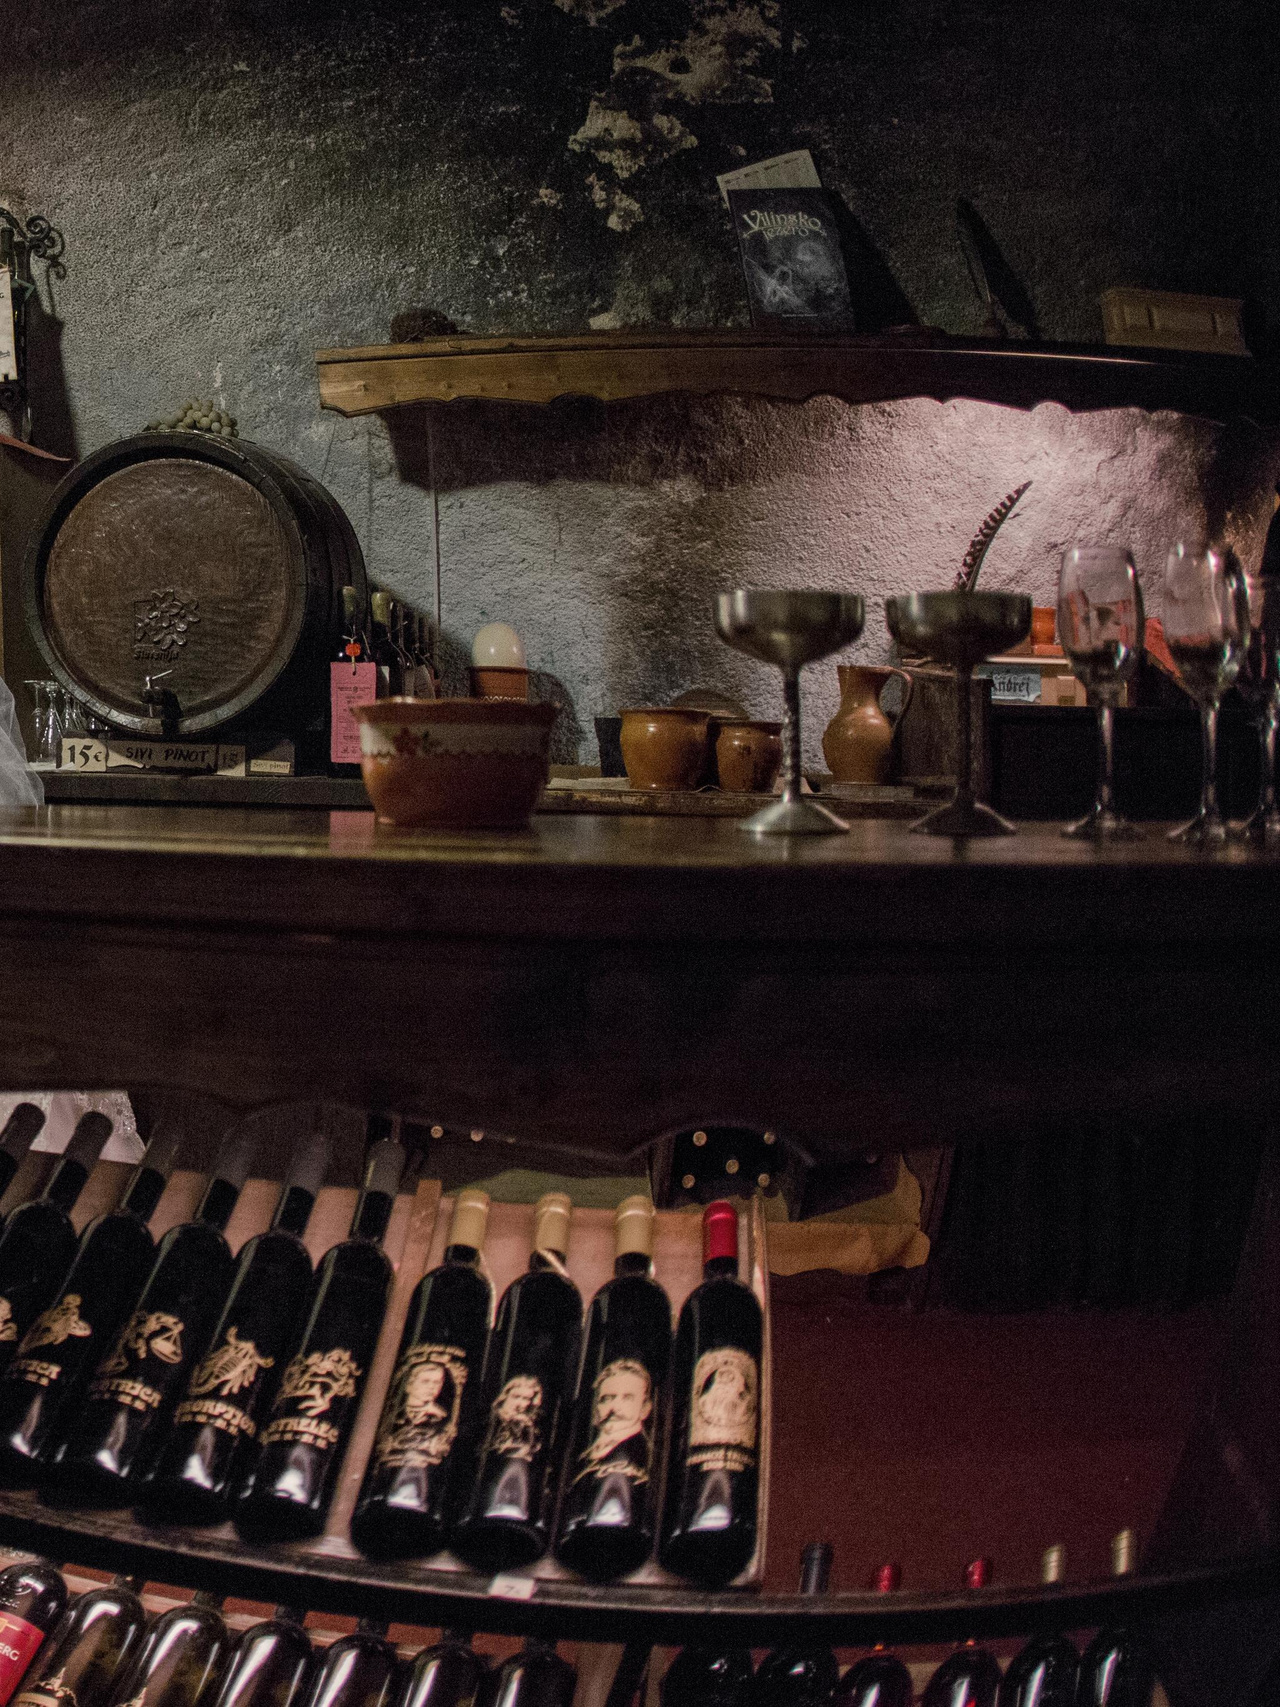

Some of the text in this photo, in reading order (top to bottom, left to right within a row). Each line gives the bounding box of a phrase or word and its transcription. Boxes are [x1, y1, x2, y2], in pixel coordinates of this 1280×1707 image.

[992, 676, 1031, 699] ndrej
[125, 747, 210, 763] SIVI PINOT
